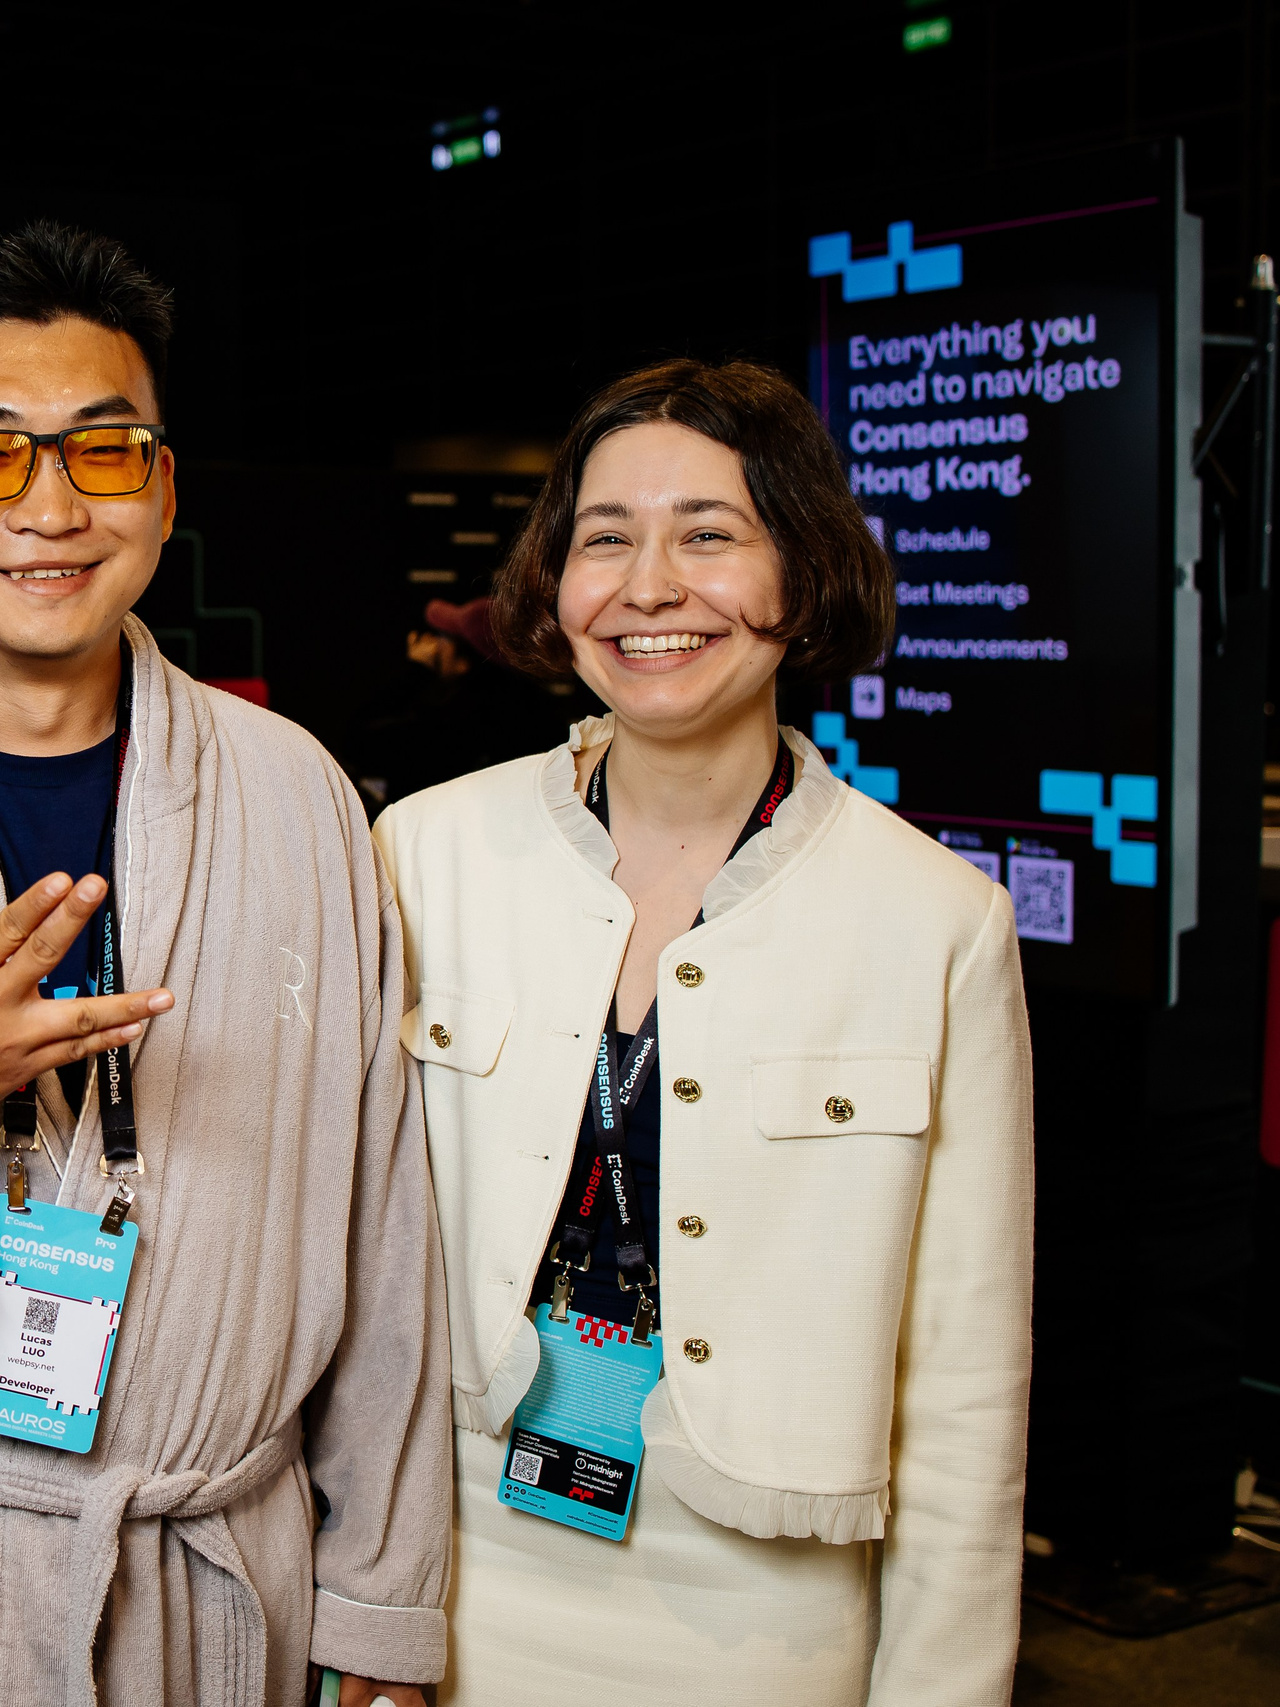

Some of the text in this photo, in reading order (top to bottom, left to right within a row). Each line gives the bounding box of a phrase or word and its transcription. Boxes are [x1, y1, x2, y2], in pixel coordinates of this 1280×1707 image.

[849, 314, 1097, 370] Everything you
[849, 356, 1121, 411] need to navigate
[849, 413, 1028, 454] Consensus
[849, 455, 1032, 501] Hong Kong.
[895, 526, 991, 553] Schedule
[933, 581, 1030, 611] Meetings
[895, 634, 1069, 661] Announcements
[895, 686, 952, 716] Maps
[102, 911, 114, 997] CONSENSU
[107, 1047, 122, 1105] CoinDesk
[624, 1036, 655, 1090] CoinDesk
[611, 1169, 630, 1225] CoinDesk
[13, 1218, 45, 1232] CoinDesk
[94, 1236, 117, 1250] Pro
[29, 1256, 60, 1275] Kong
[20, 1332, 53, 1347] Lucas
[21, 1345, 46, 1358] LUO
[7, 1355, 55, 1373] webpsy.net
[587, 1462, 624, 1480] midnight
